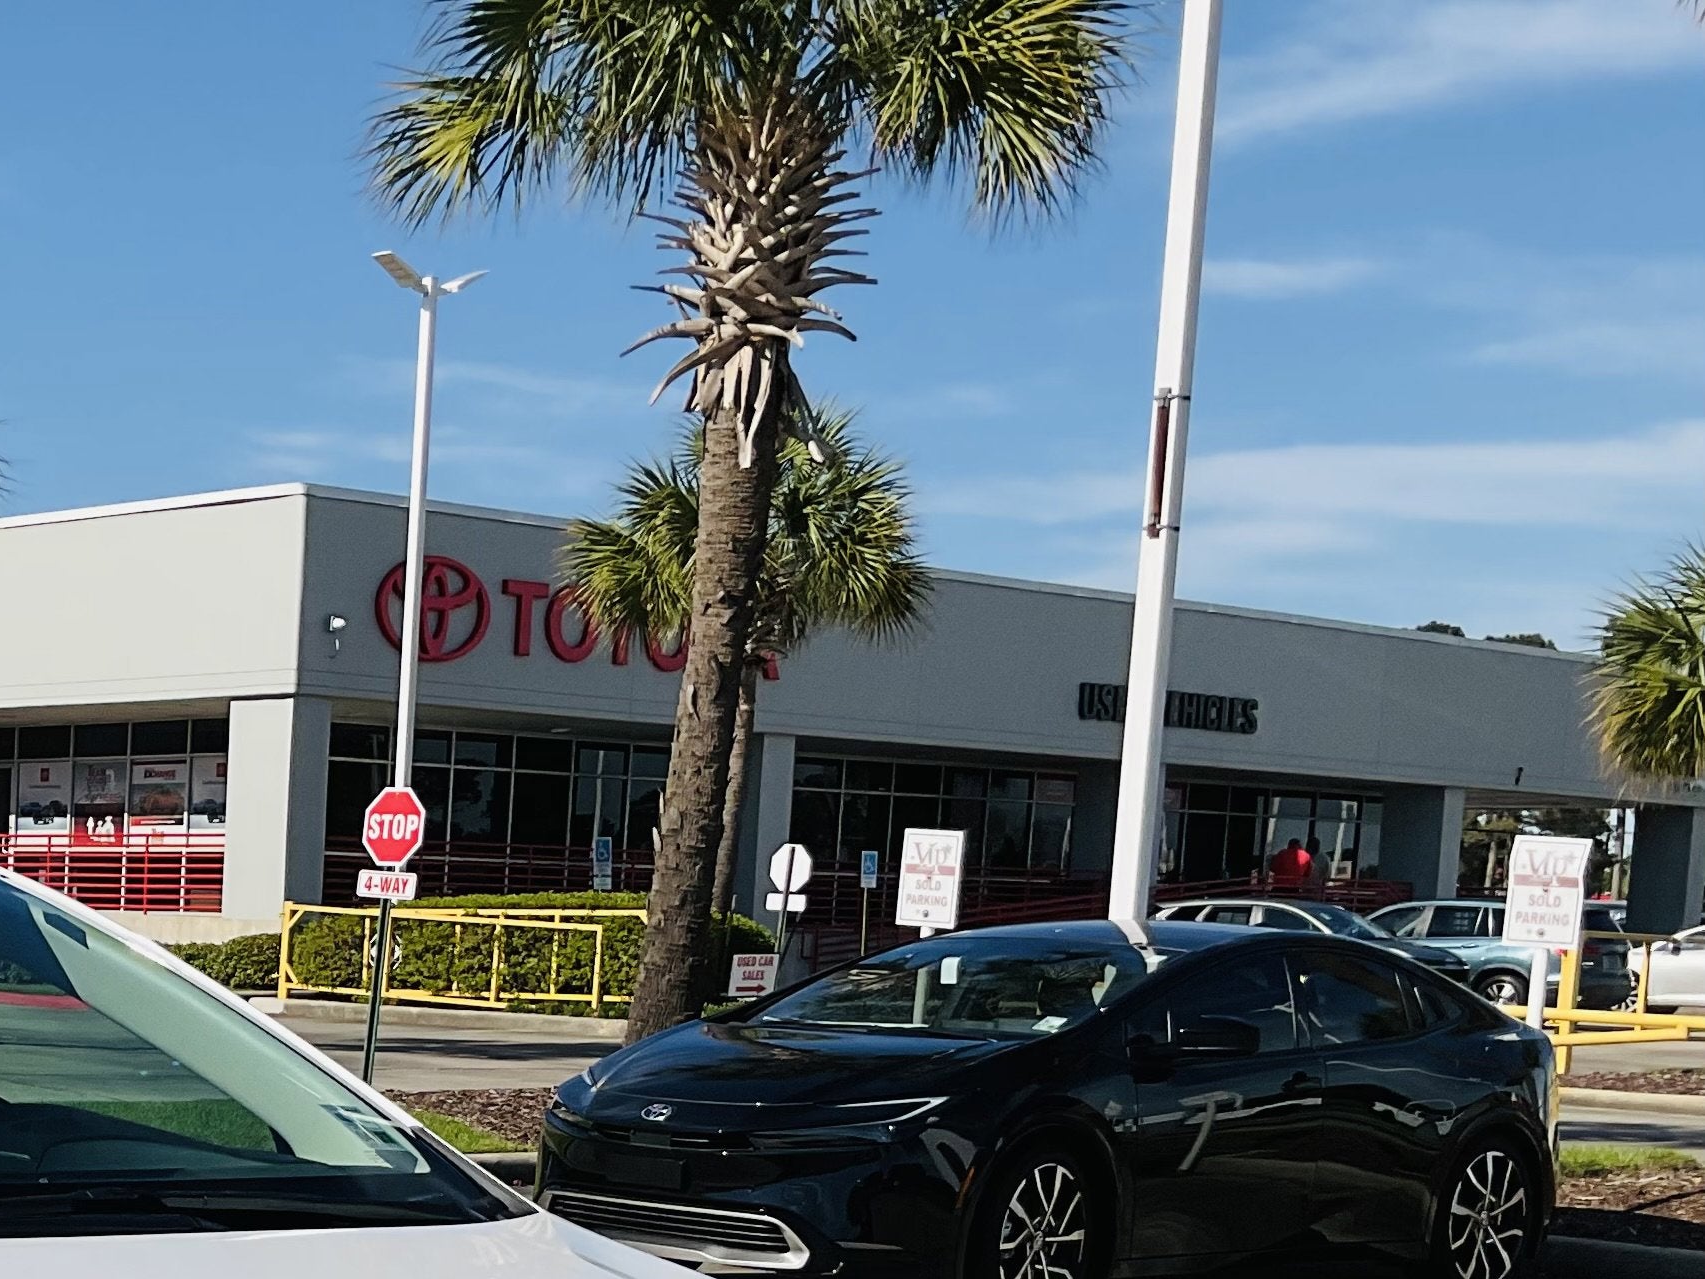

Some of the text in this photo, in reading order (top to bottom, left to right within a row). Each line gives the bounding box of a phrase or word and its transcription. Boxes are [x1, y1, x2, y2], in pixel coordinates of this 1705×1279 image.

[1079, 687, 1259, 735] USE EHICLES
[368, 813, 420, 841] STOP
[364, 875, 410, 895] 4-WAY
[915, 880, 942, 891] SOLD
[905, 894, 948, 907] PARKING
[1528, 894, 1562, 908] SOLD
[1515, 911, 1570, 927] PARKING
[737, 956, 774, 967] USED CAR
[742, 970, 765, 980] SALES
